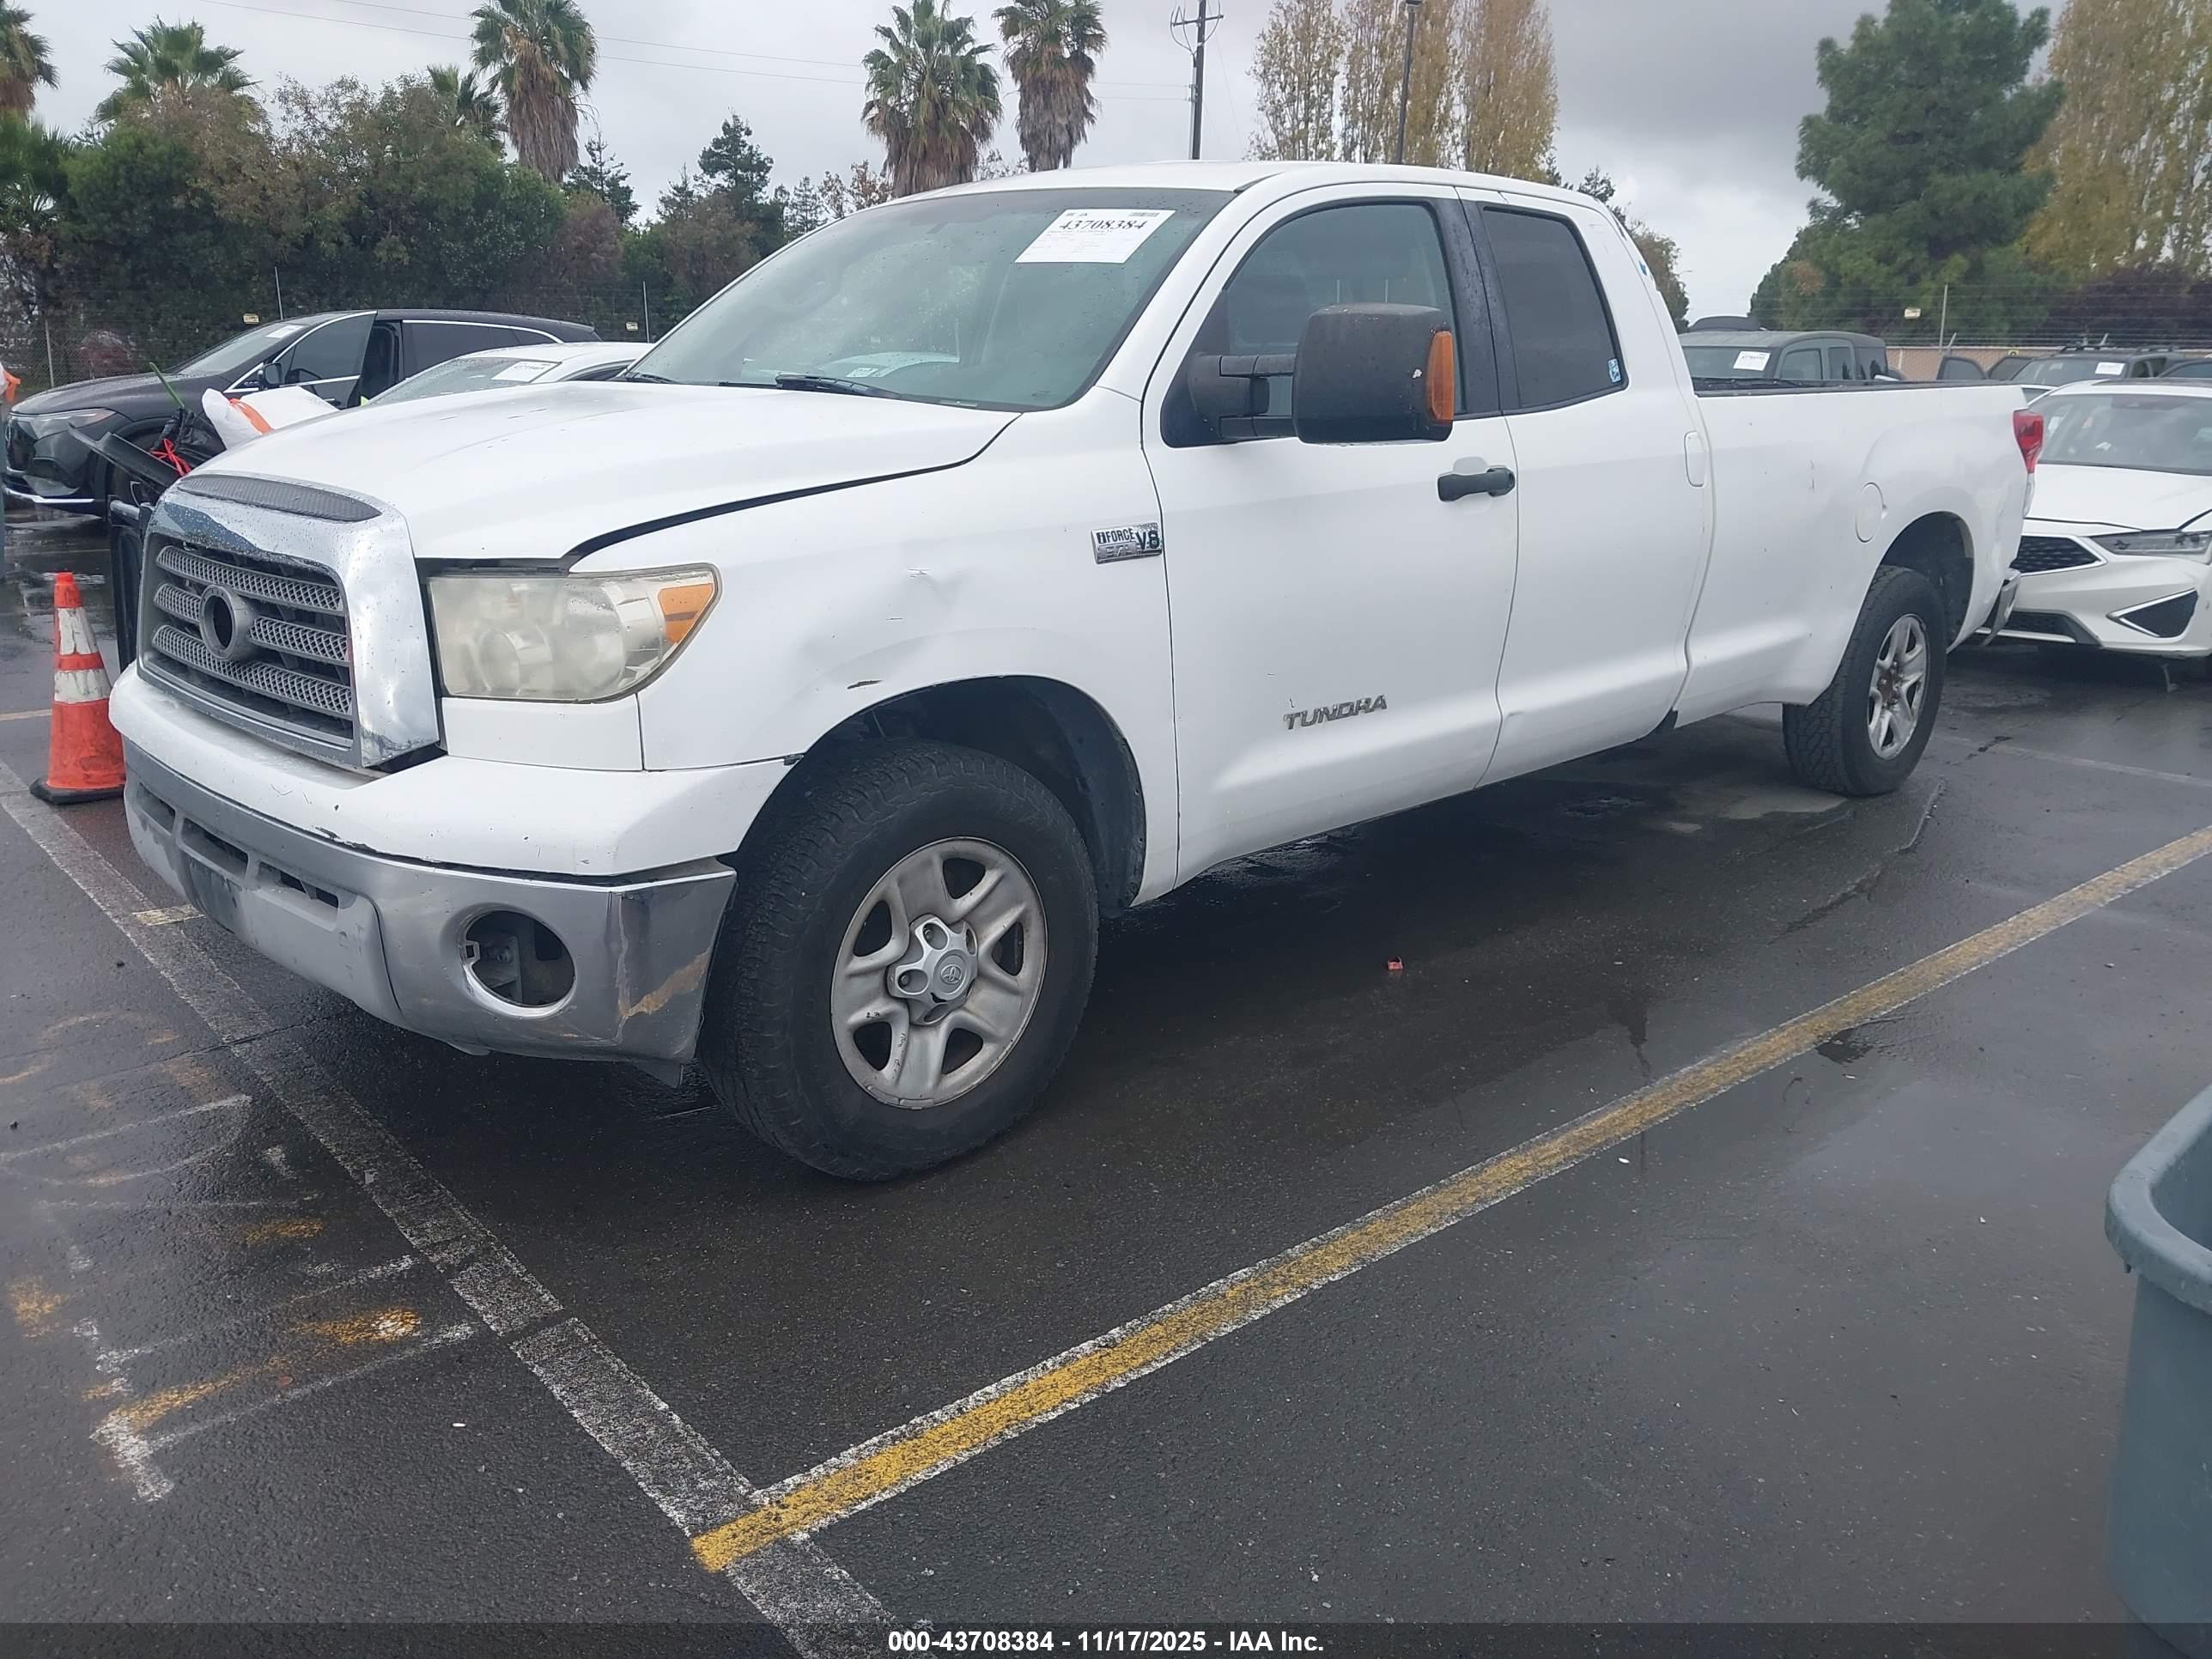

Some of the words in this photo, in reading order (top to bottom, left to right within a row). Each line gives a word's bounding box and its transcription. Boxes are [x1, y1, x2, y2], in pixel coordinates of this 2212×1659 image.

[1059, 220, 1148, 230] 43708384
[1135, 530, 1160, 550] V8
[1283, 694, 1388, 731] TUNDRA
